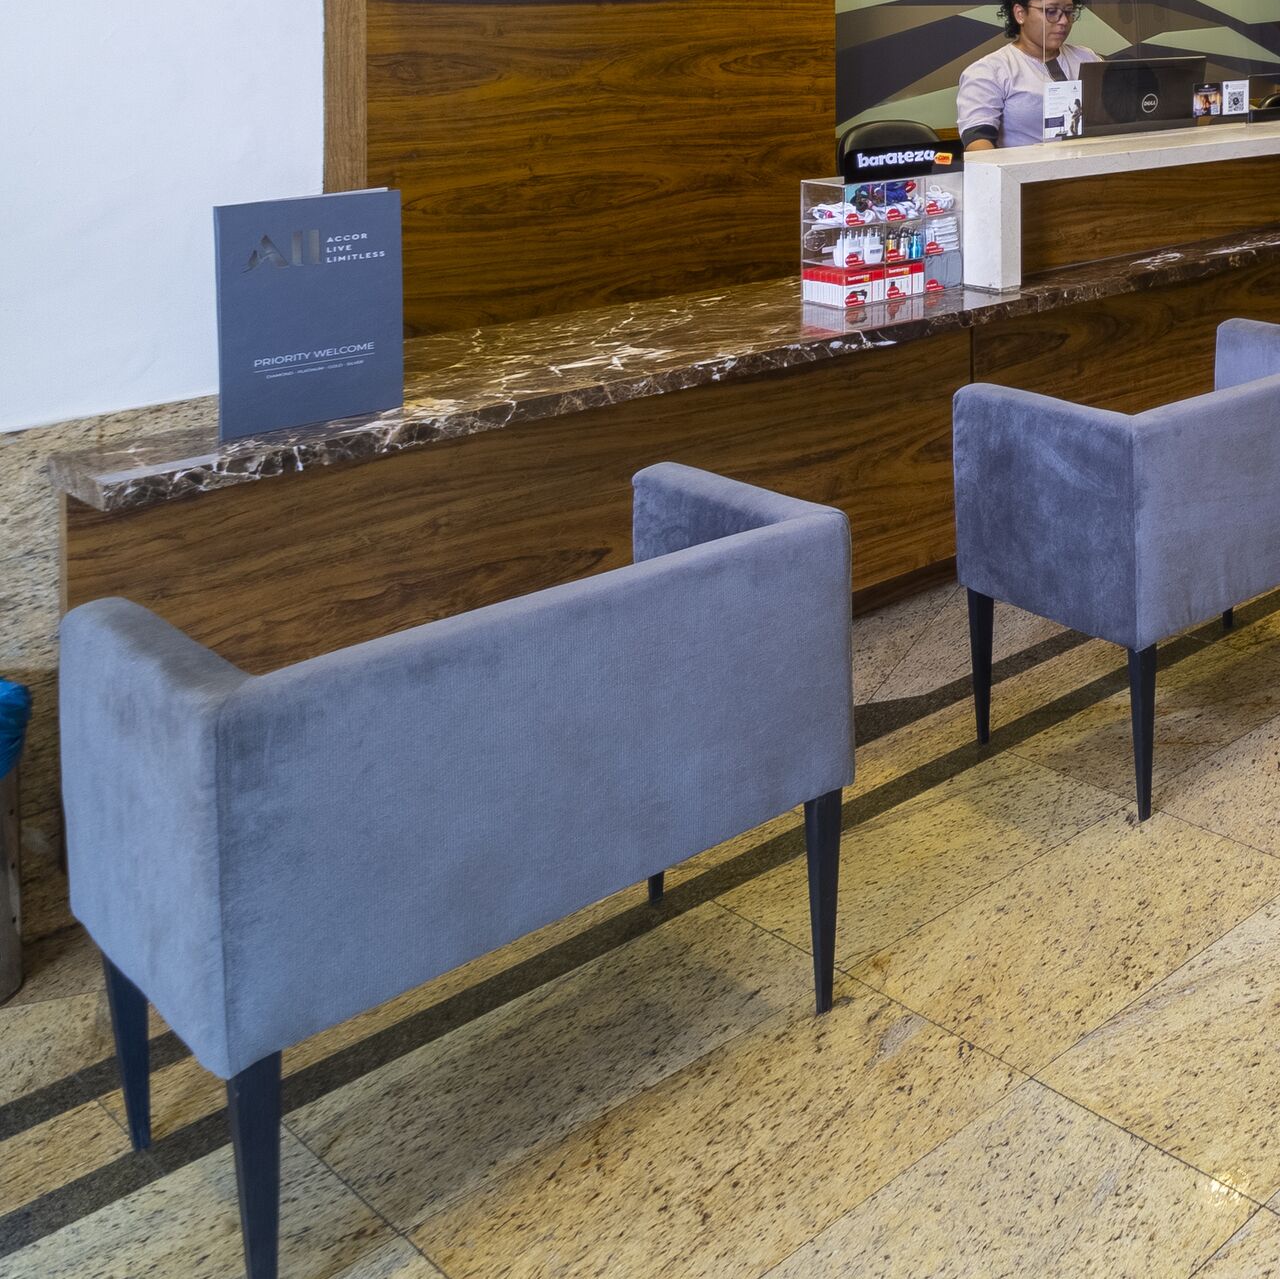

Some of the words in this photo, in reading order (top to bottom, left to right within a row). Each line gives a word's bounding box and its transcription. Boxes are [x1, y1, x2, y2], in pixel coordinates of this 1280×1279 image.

[326, 232, 368, 243] ACCOR
[326, 244, 352, 253] LIVE
[326, 250, 386, 263] LIMITLESS
[254, 352, 311, 367] PRIORITY
[313, 341, 375, 358] WELCOME
